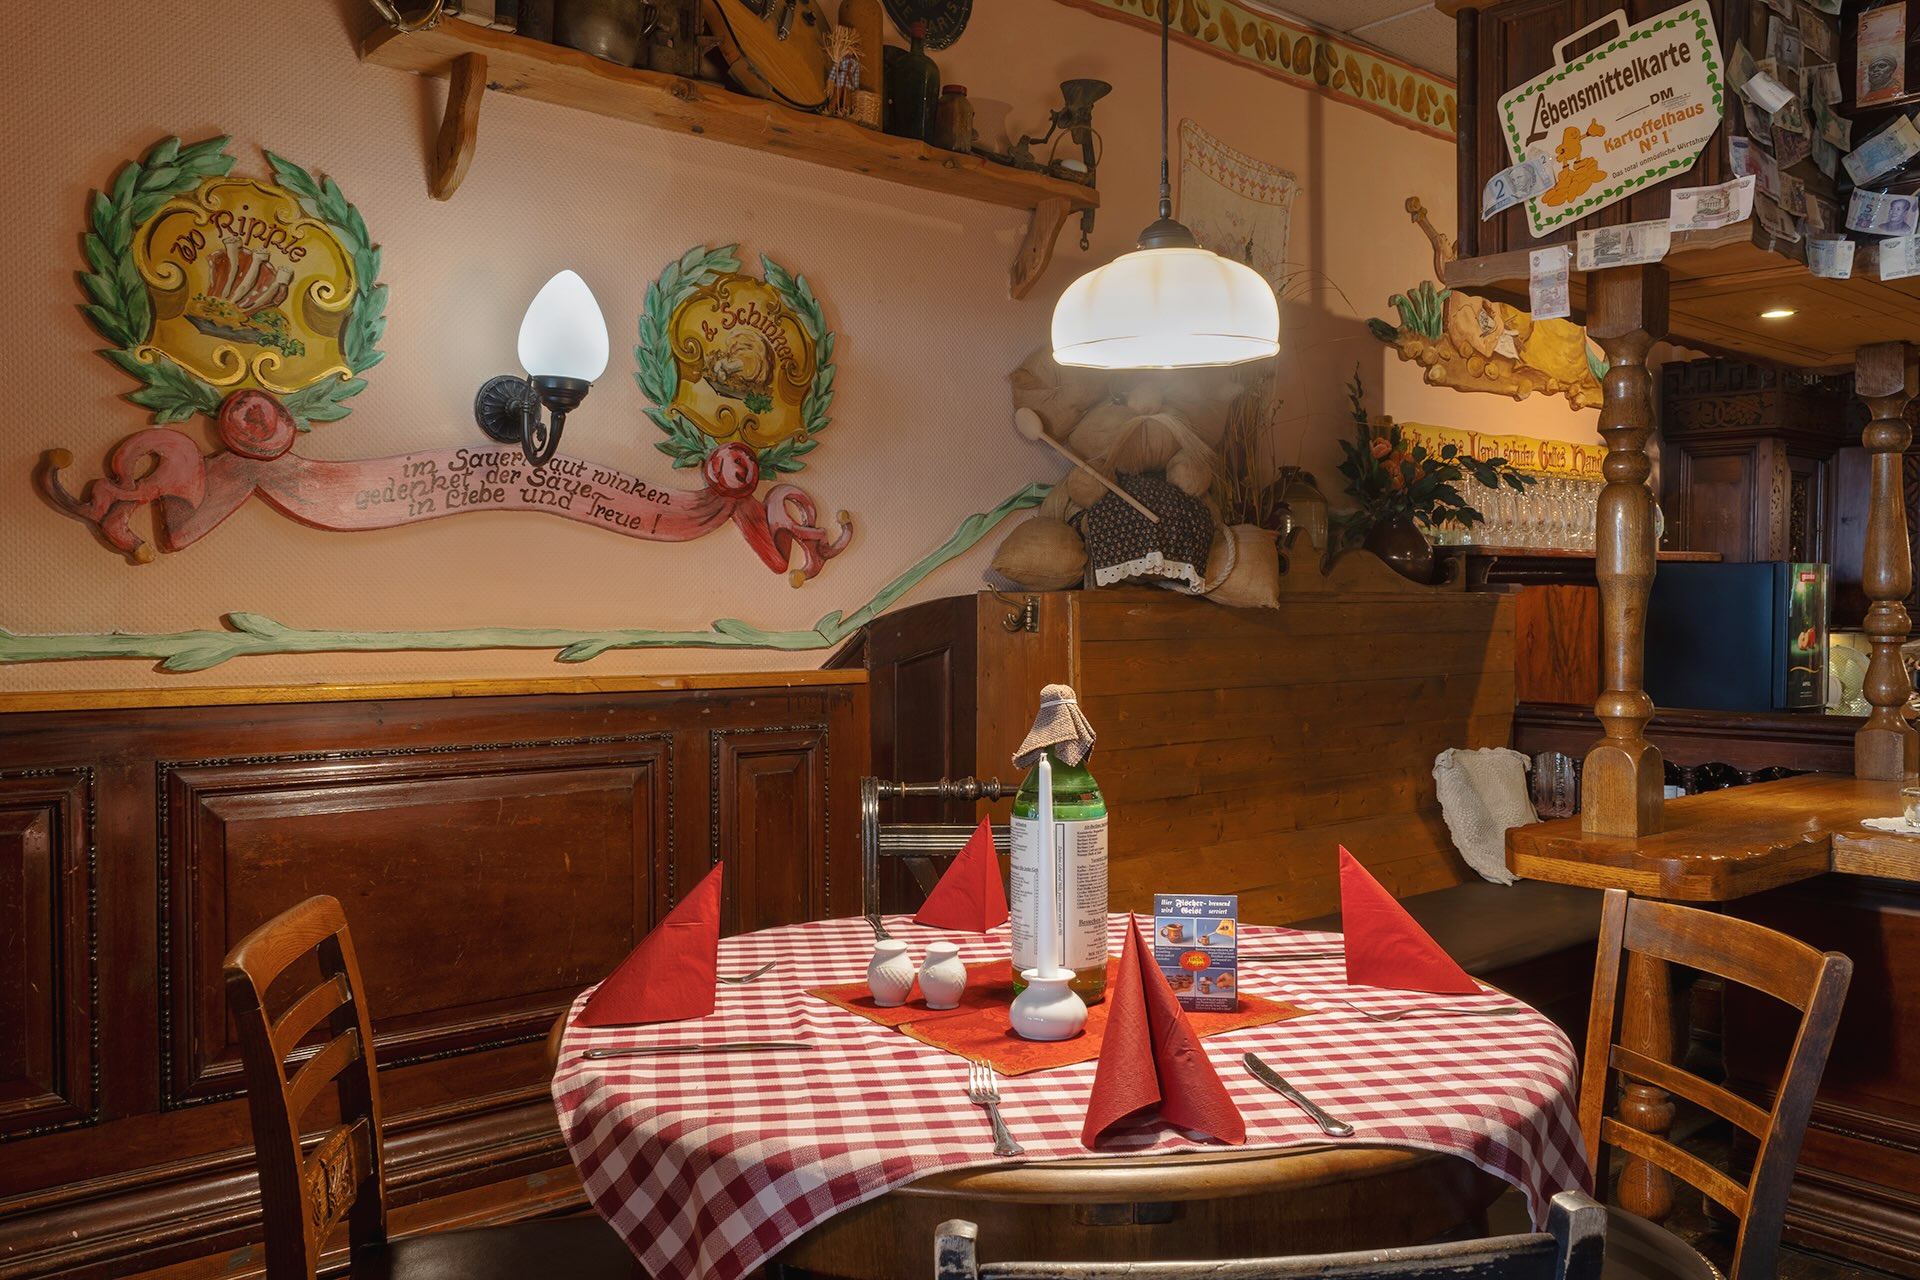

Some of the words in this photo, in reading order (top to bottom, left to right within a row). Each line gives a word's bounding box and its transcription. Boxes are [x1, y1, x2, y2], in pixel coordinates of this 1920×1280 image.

[1786, 38, 1792, 53] 2
[1526, 41, 1692, 147] Lebensmittelkarte
[1649, 87, 1675, 105] DM
[1603, 102, 1705, 154] Kartoffelhaus
[1541, 155, 1547, 164] 2
[1612, 169, 1624, 179] Das
[1624, 161, 1639, 175] total
[1494, 179, 1506, 200] 2
[1864, 204, 1873, 213] 5
[208, 204, 308, 263] Ripple
[702, 319, 718, 343] &
[1570, 444, 1604, 474] Hand
[354, 467, 474, 510] gedenket
[486, 464, 521, 485] der
[401, 455, 438, 479] im
[448, 448, 588, 479] Saueraut
[593, 469, 673, 506] winken
[408, 495, 436, 518] in
[445, 480, 506, 511] Liebe
[520, 486, 572, 511] und
[586, 491, 642, 531] Treue
